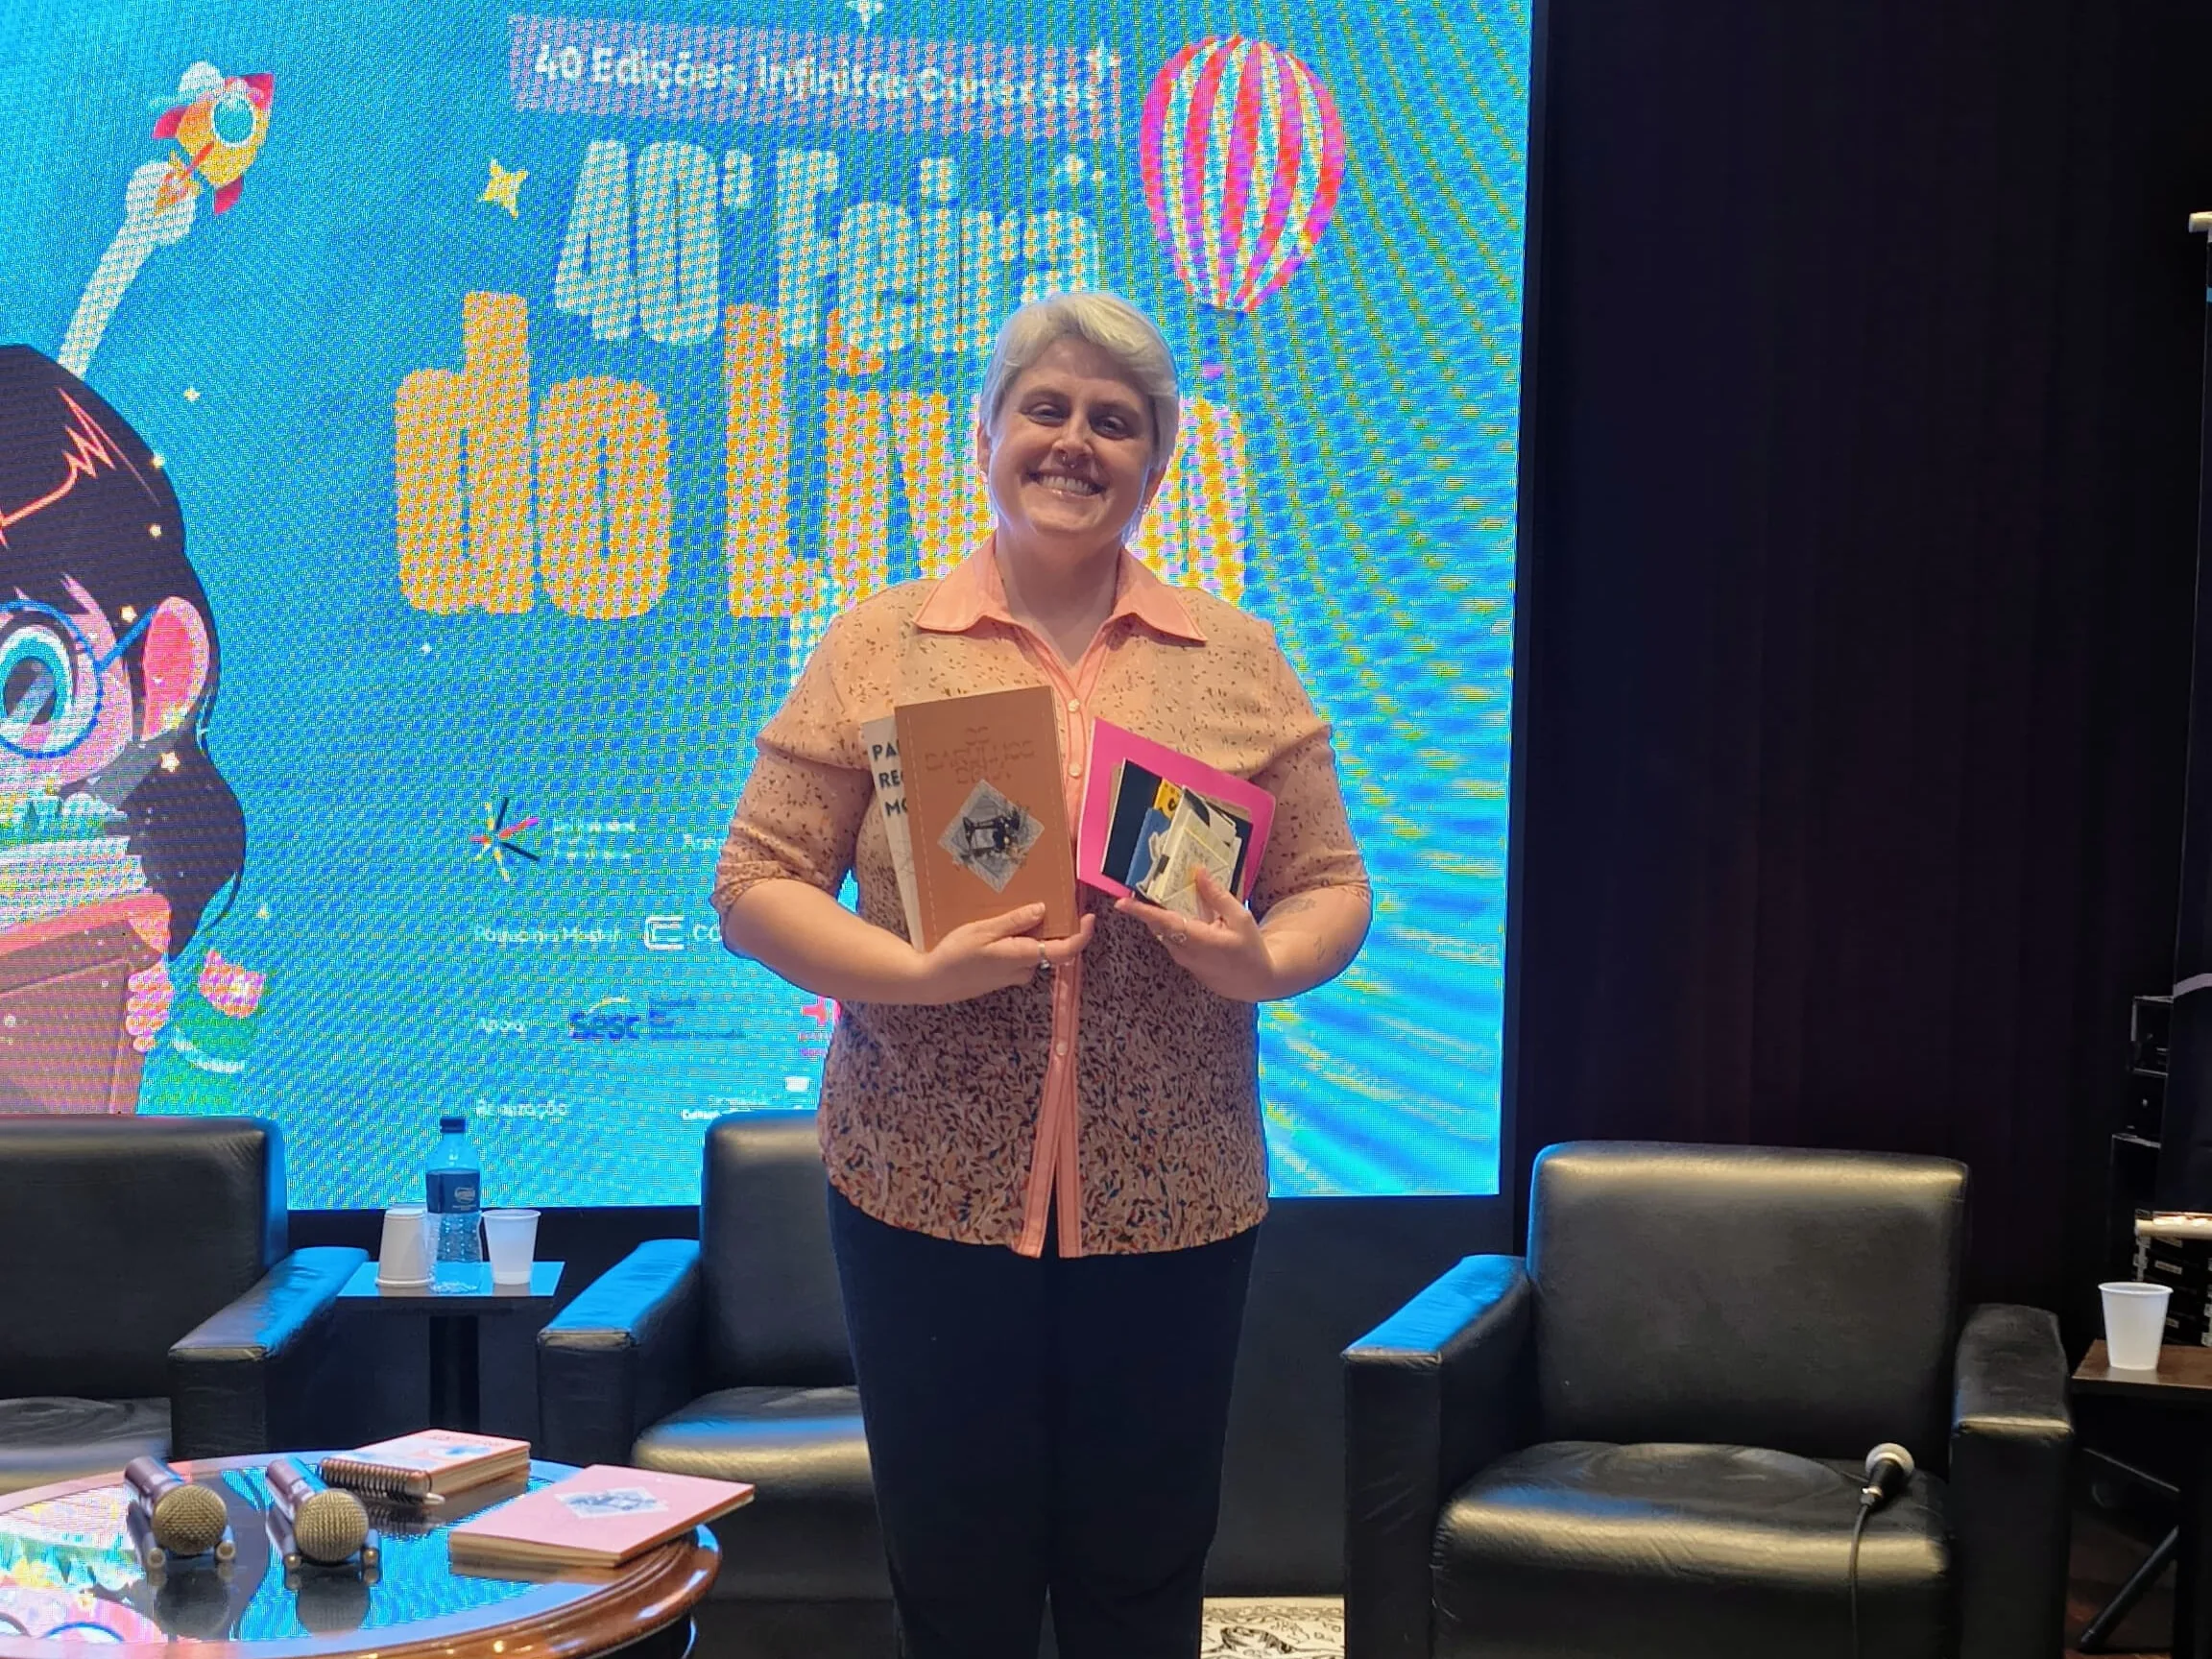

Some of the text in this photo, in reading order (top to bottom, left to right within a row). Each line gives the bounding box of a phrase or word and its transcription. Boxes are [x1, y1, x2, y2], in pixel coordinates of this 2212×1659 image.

[535, 44, 581, 81] 40
[395, 291, 1246, 620] do Livo
[872, 738, 901, 762] PA
[878, 769, 903, 788] RE
